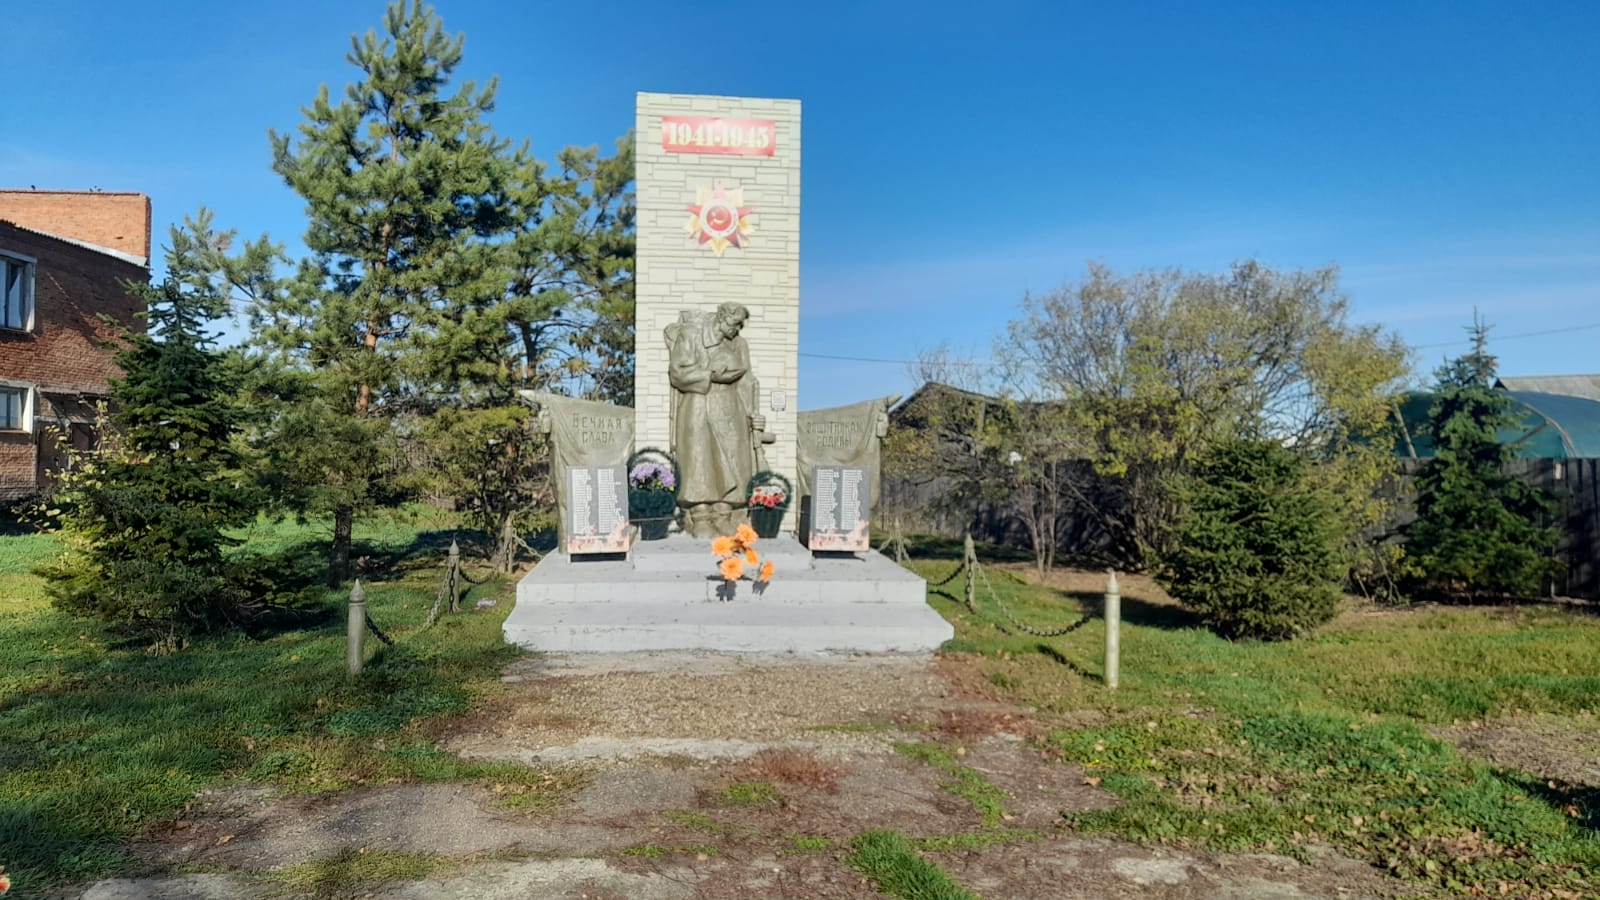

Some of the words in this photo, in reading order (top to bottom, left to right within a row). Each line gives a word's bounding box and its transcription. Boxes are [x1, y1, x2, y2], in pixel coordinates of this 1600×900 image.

[669, 122, 769, 148] 1941-1945
[572, 412, 622, 430] ВЕЧНАЯ
[582, 431, 615, 444] СЛАВА
